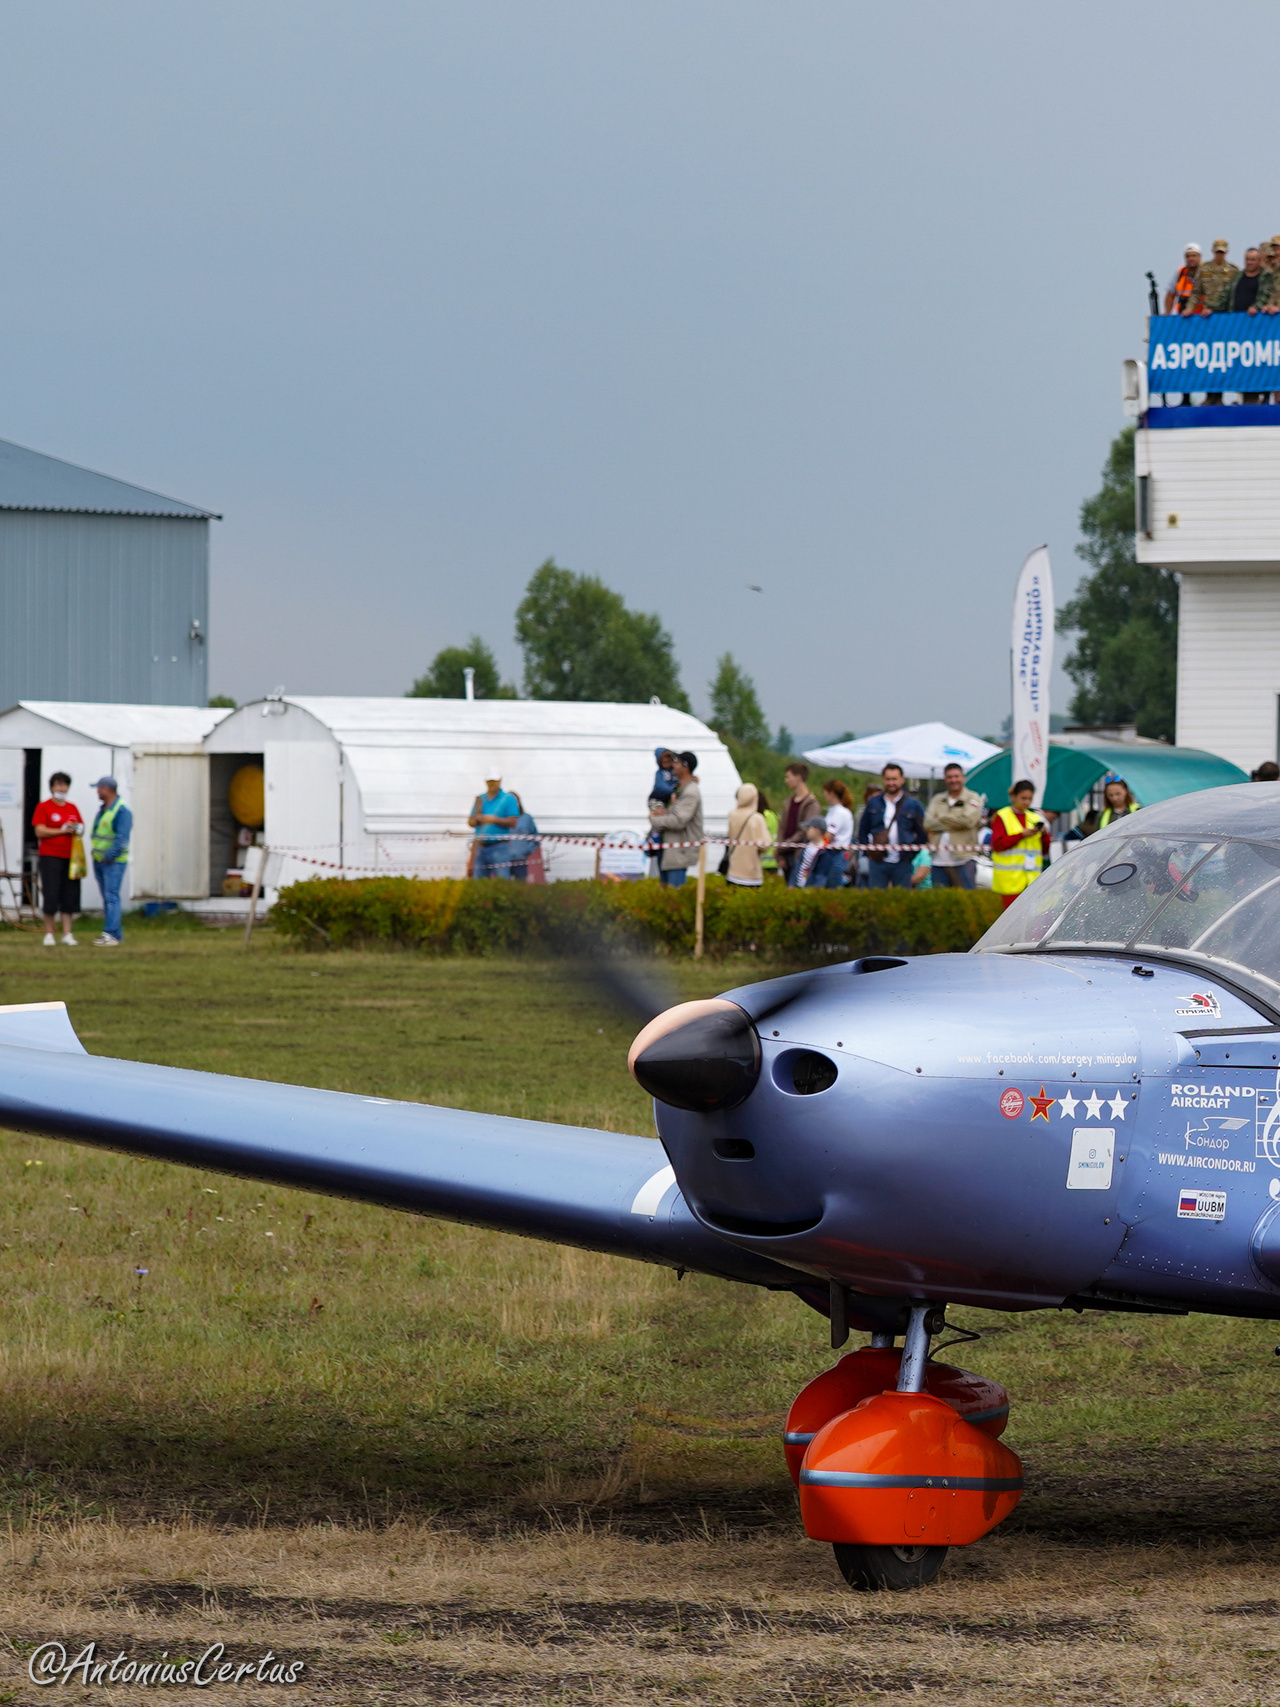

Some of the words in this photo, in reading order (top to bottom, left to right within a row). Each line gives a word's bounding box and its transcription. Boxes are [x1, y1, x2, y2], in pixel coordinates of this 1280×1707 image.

[957, 1052, 1137, 1067] www.facebook.com/sergey.minigulov
[1171, 1084, 1256, 1097] ROLAND
[1171, 1097, 1230, 1109] AIRCRAFT
[1158, 1153, 1256, 1172] WWW.AIRCONDOR.RU
[1198, 1201, 1225, 1213] UUBM
